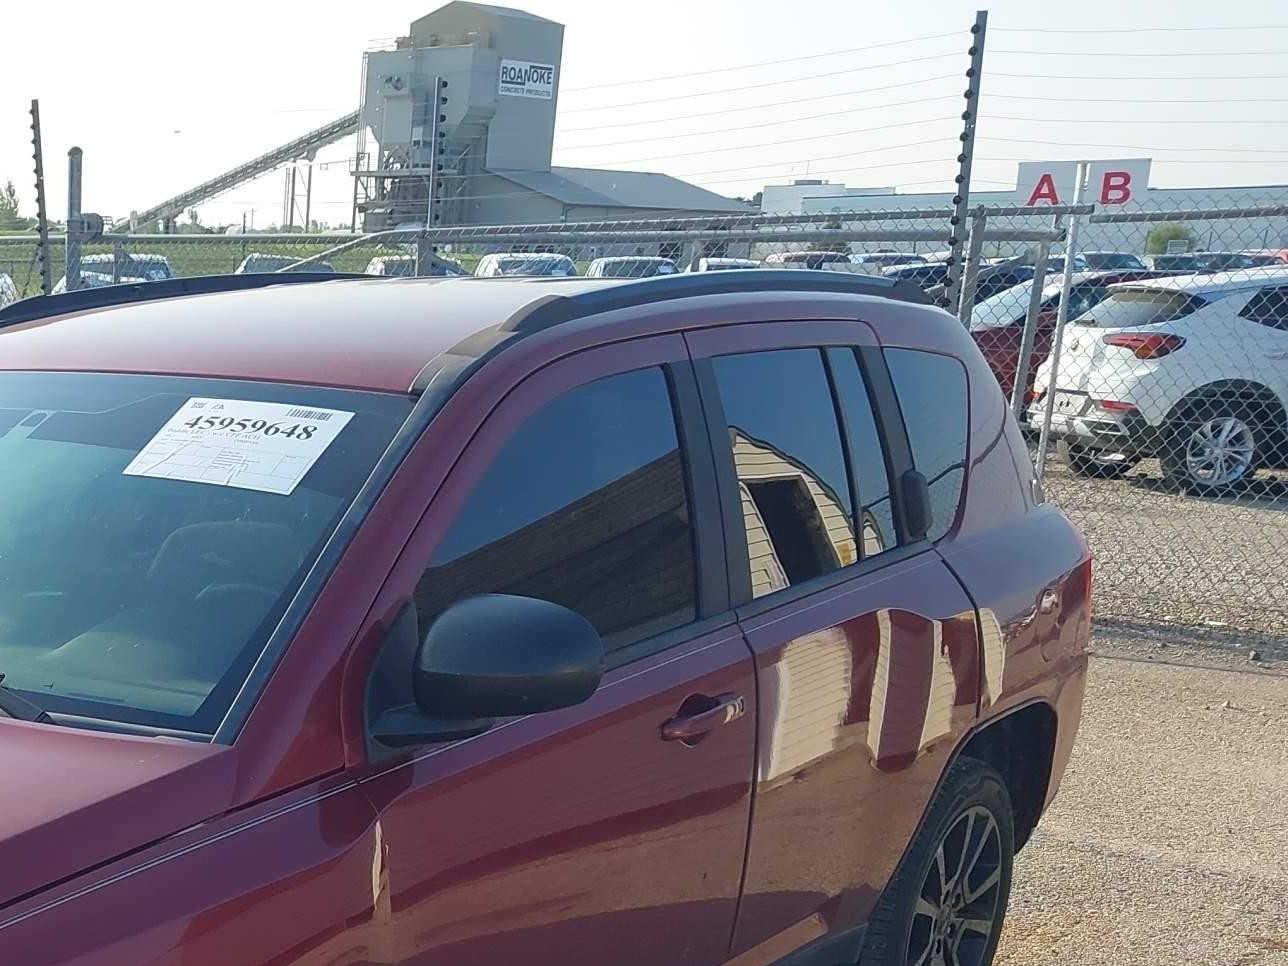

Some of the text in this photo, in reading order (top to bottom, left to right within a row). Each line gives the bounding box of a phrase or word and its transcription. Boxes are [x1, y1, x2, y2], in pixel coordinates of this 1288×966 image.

[502, 65, 552, 85] ROANOKE
[1027, 173, 1058, 206] A
[1100, 172, 1132, 205] B
[184, 415, 318, 440] 45959648
